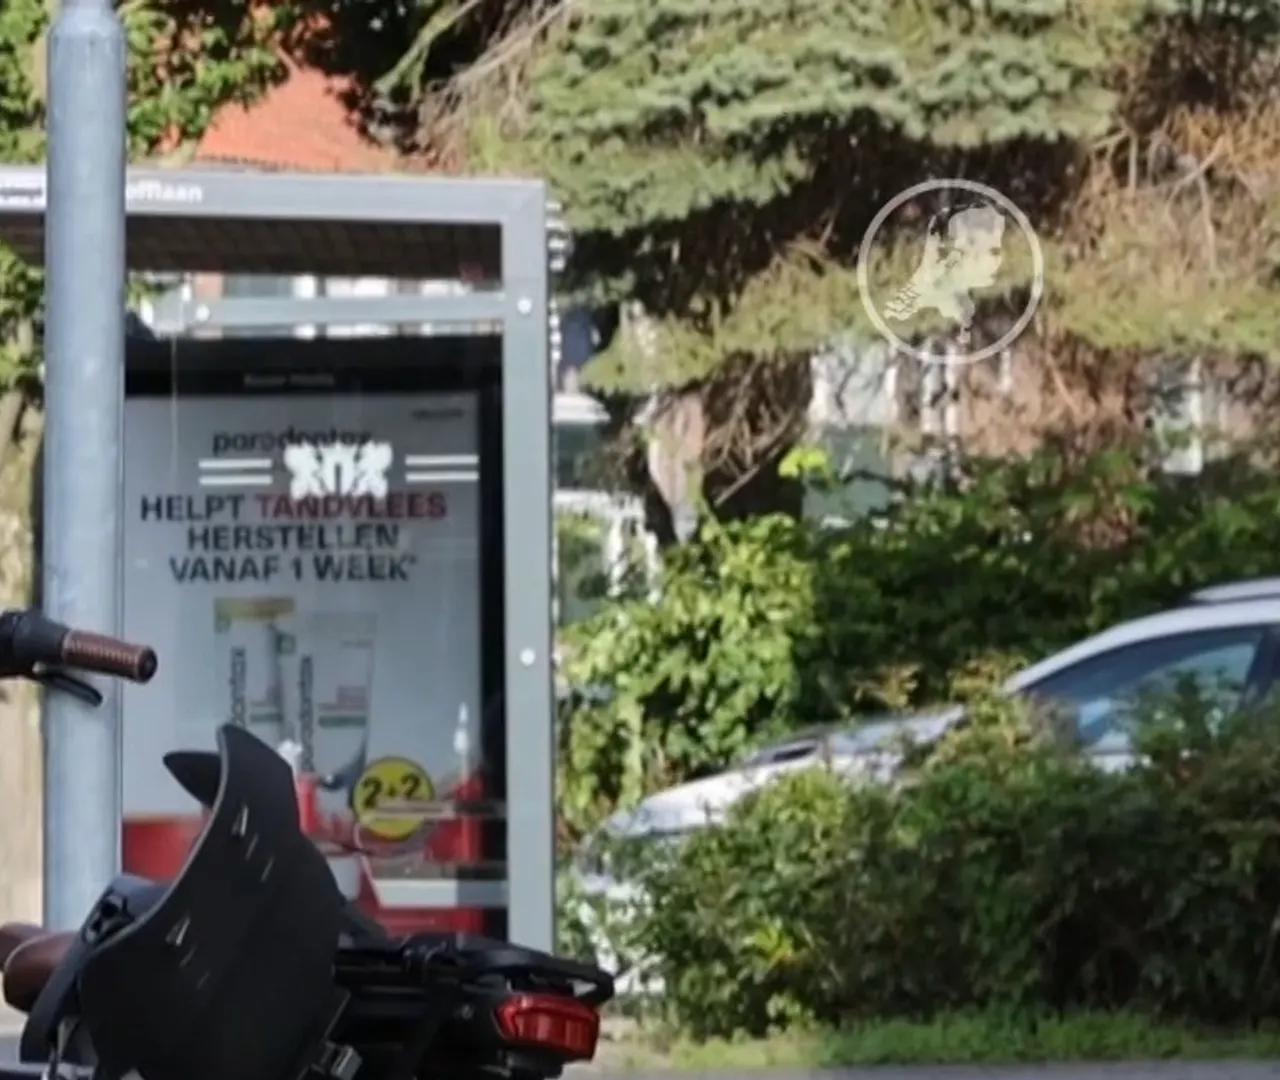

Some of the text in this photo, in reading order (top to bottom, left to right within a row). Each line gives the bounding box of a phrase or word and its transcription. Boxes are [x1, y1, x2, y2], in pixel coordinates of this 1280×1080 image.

[140, 493, 448, 521] HELPT TANDVLEES
[188, 525, 399, 551] HERSTELLEN
[169, 554, 280, 582] VANAF
[290, 557, 302, 581] 1
